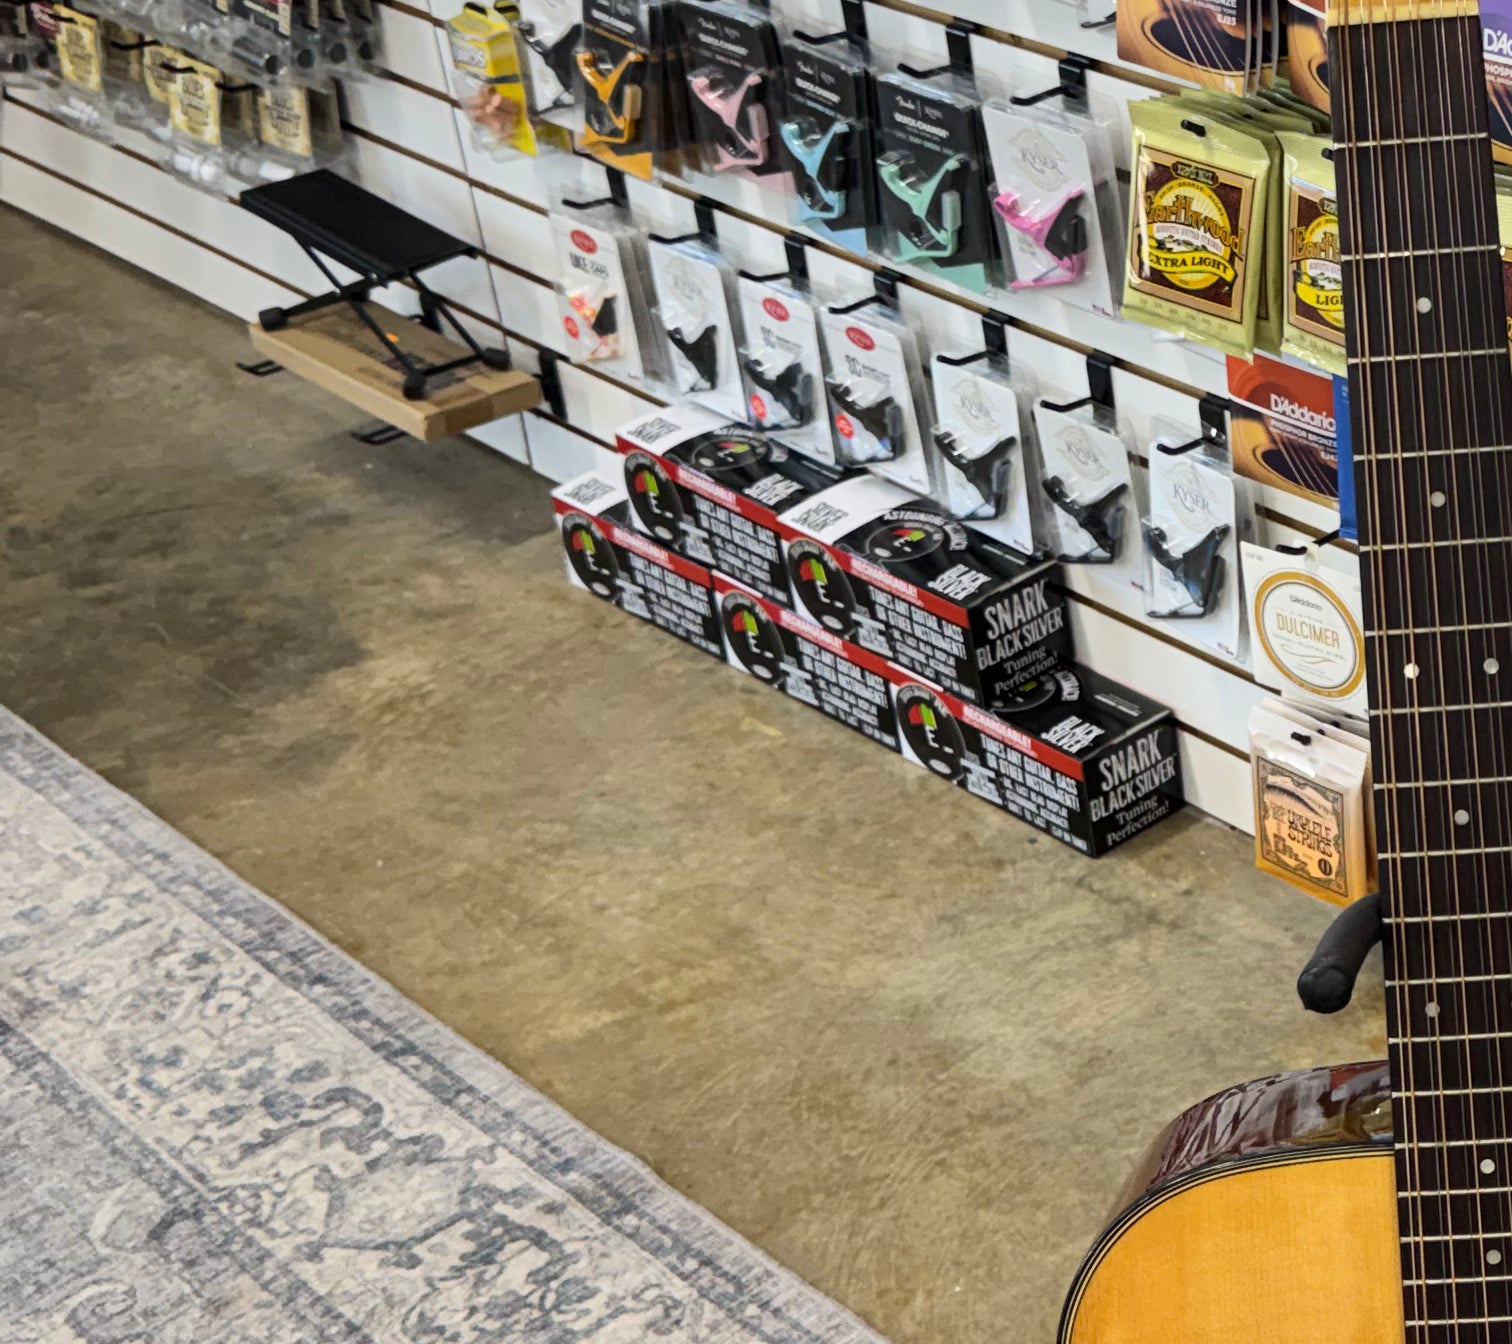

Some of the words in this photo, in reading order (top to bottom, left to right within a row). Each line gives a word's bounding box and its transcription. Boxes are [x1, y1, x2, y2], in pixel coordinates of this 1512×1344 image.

[984, 579, 1047, 640] SNARK
[1277, 613, 1340, 649] DULCIMER
[1099, 728, 1163, 790] SNARK
[1106, 801, 1171, 847] Perfection!
[1117, 795, 1159, 824] Tuning
